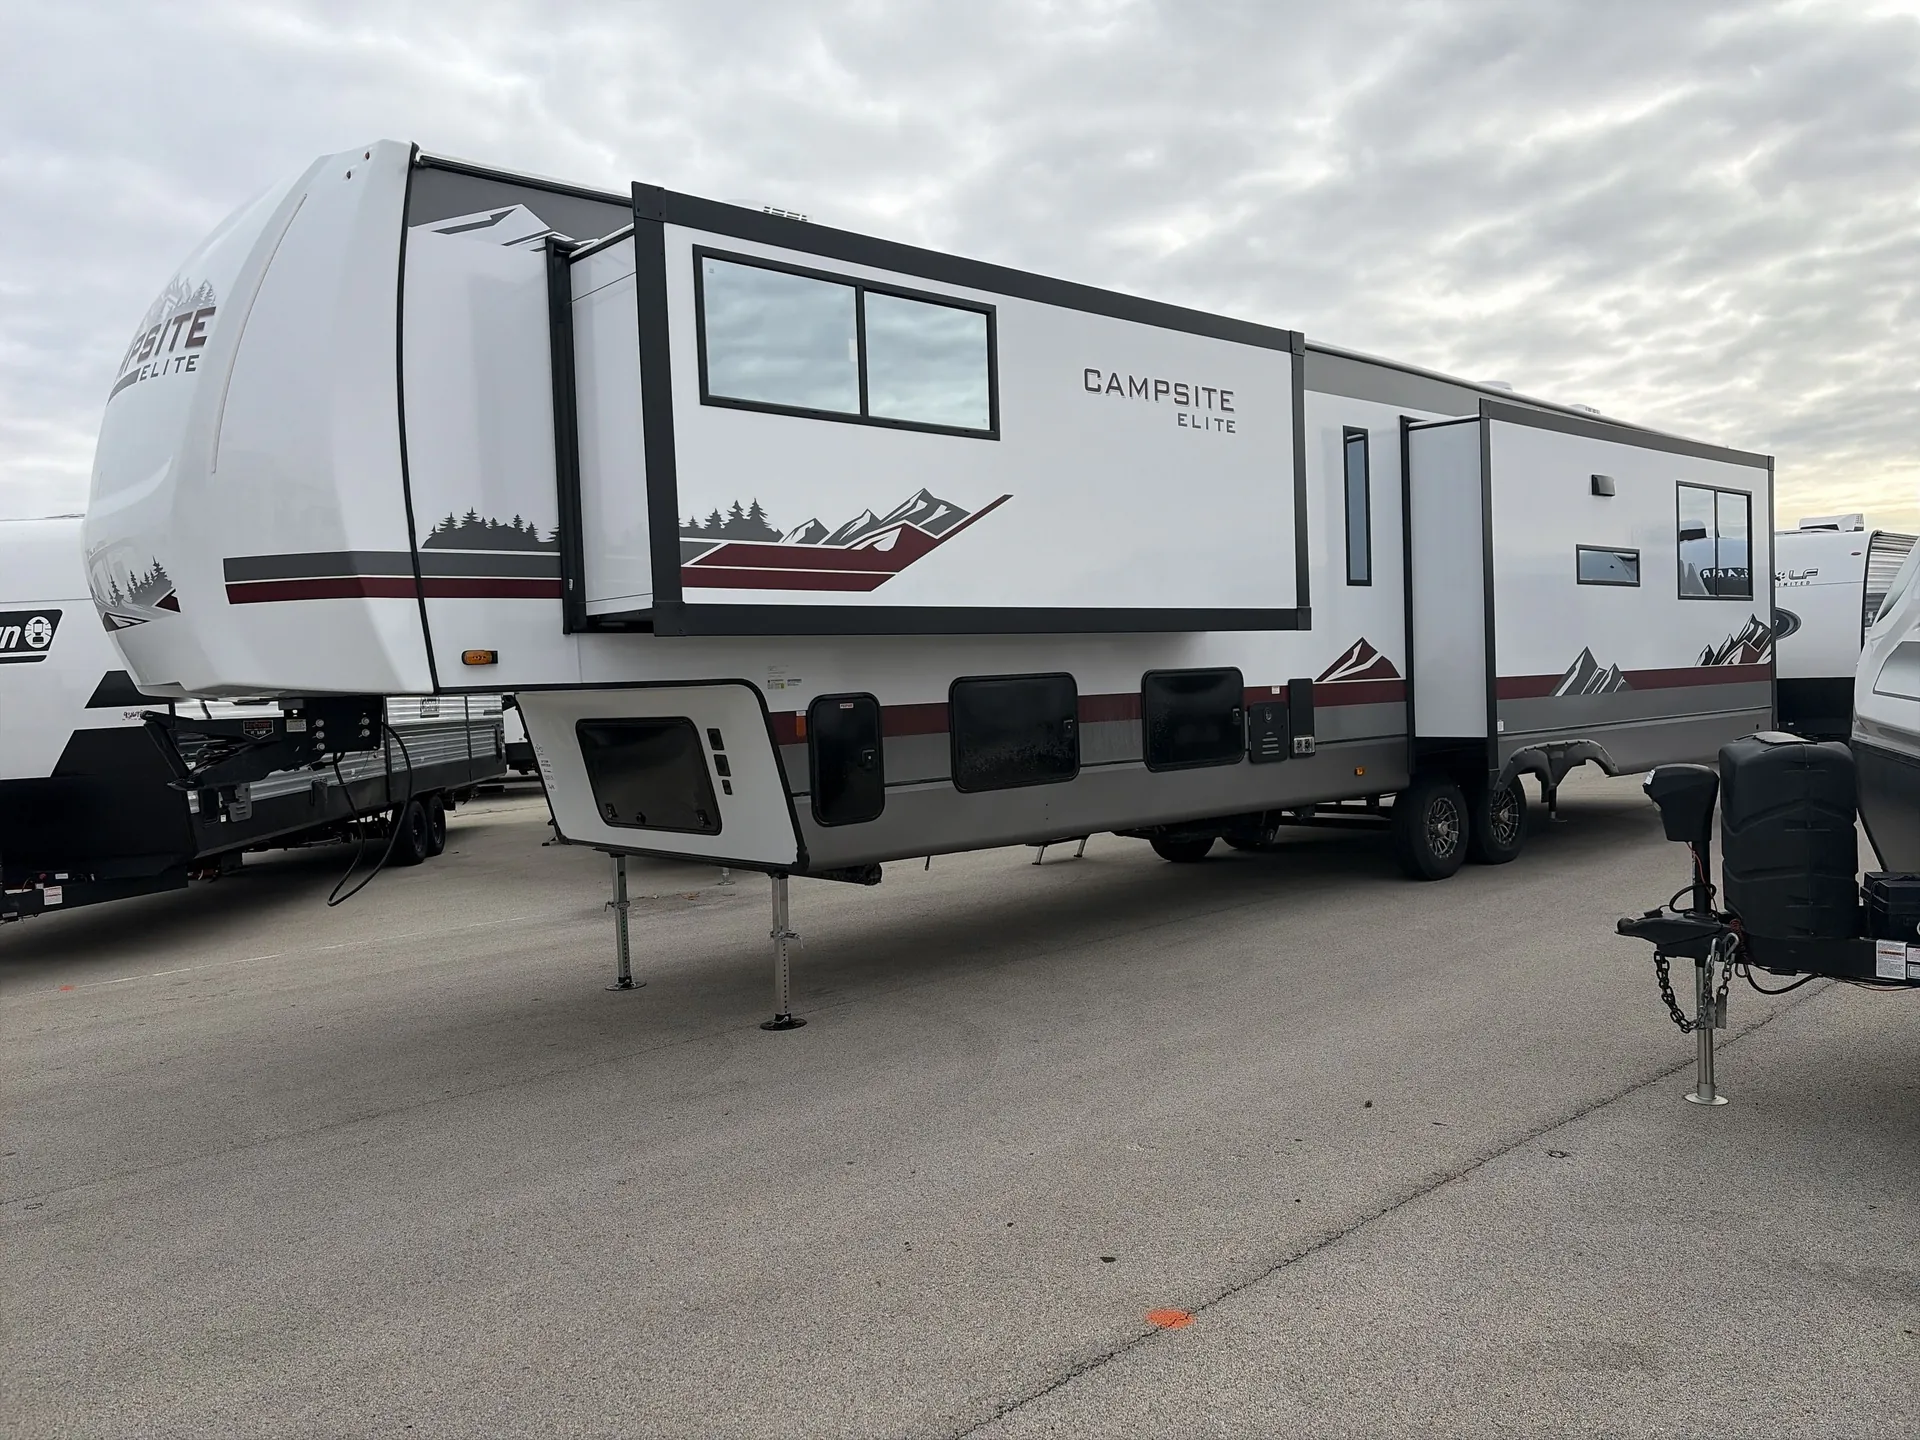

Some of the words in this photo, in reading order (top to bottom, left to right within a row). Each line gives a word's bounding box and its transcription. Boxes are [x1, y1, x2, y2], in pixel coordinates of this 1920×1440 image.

[139, 354, 200, 381] ELITE
[1083, 367, 1236, 413] CAMPSITE
[1177, 412, 1236, 434] ELITE
[1775, 580, 1811, 588] IMITED
[0, 625, 21, 649] n
